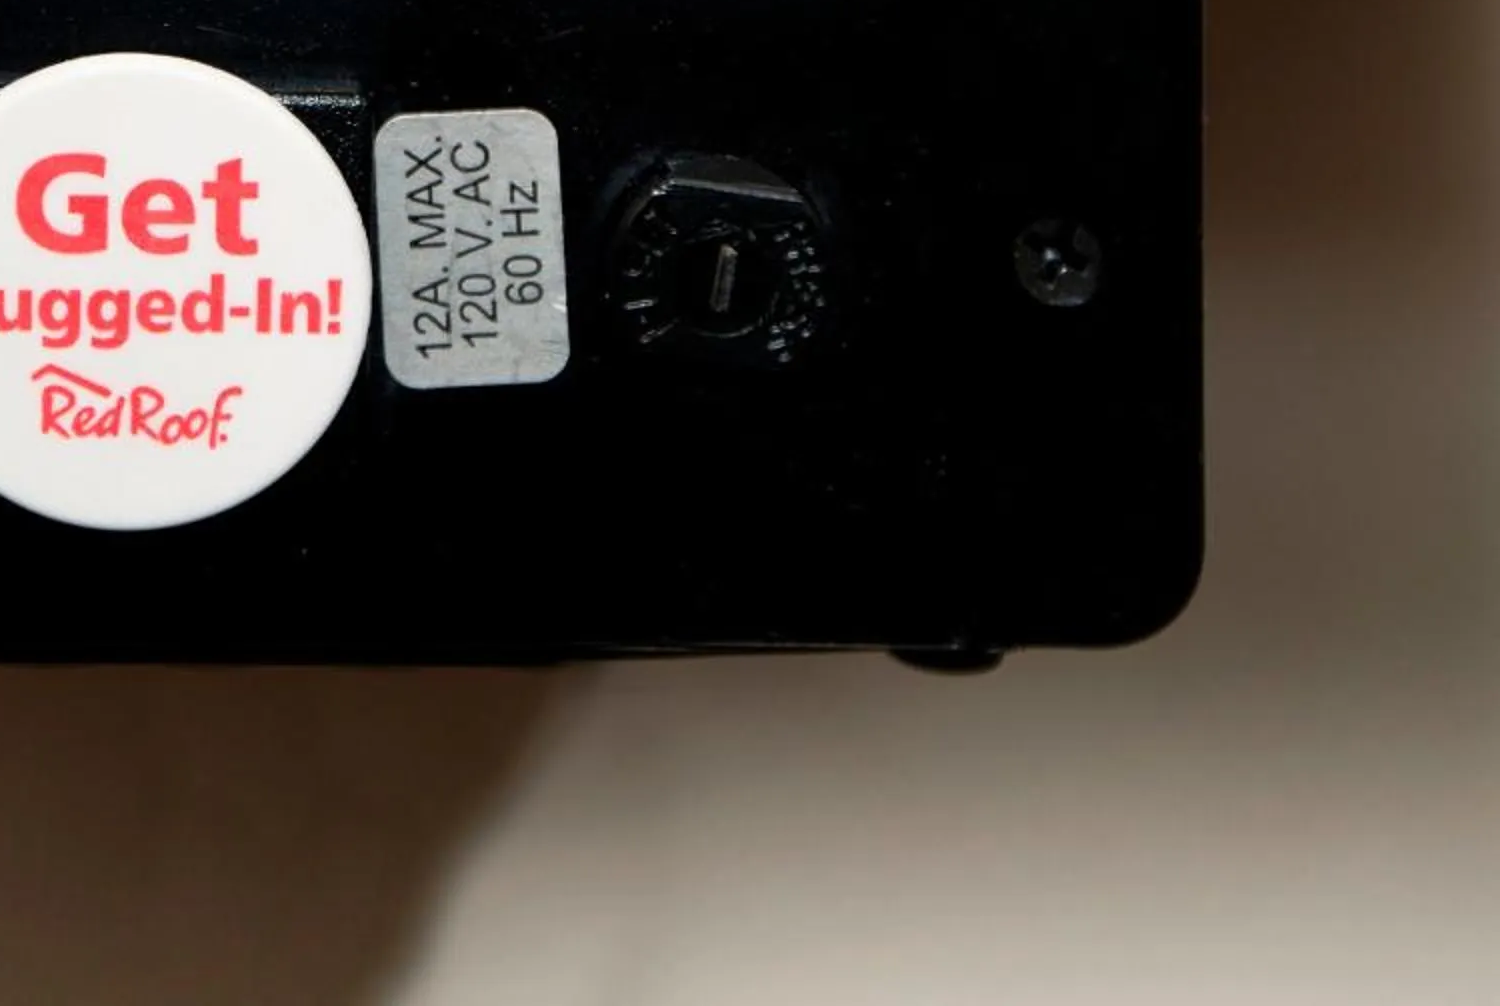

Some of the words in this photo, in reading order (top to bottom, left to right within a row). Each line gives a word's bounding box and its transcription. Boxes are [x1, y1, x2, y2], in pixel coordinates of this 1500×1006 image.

[15, 152, 260, 257] Get
[404, 136, 447, 249] MAX.
[500, 181, 539, 237] Hz
[412, 266, 451, 358] 12A.
[457, 274, 498, 347] 120
[502, 255, 544, 305] 60
